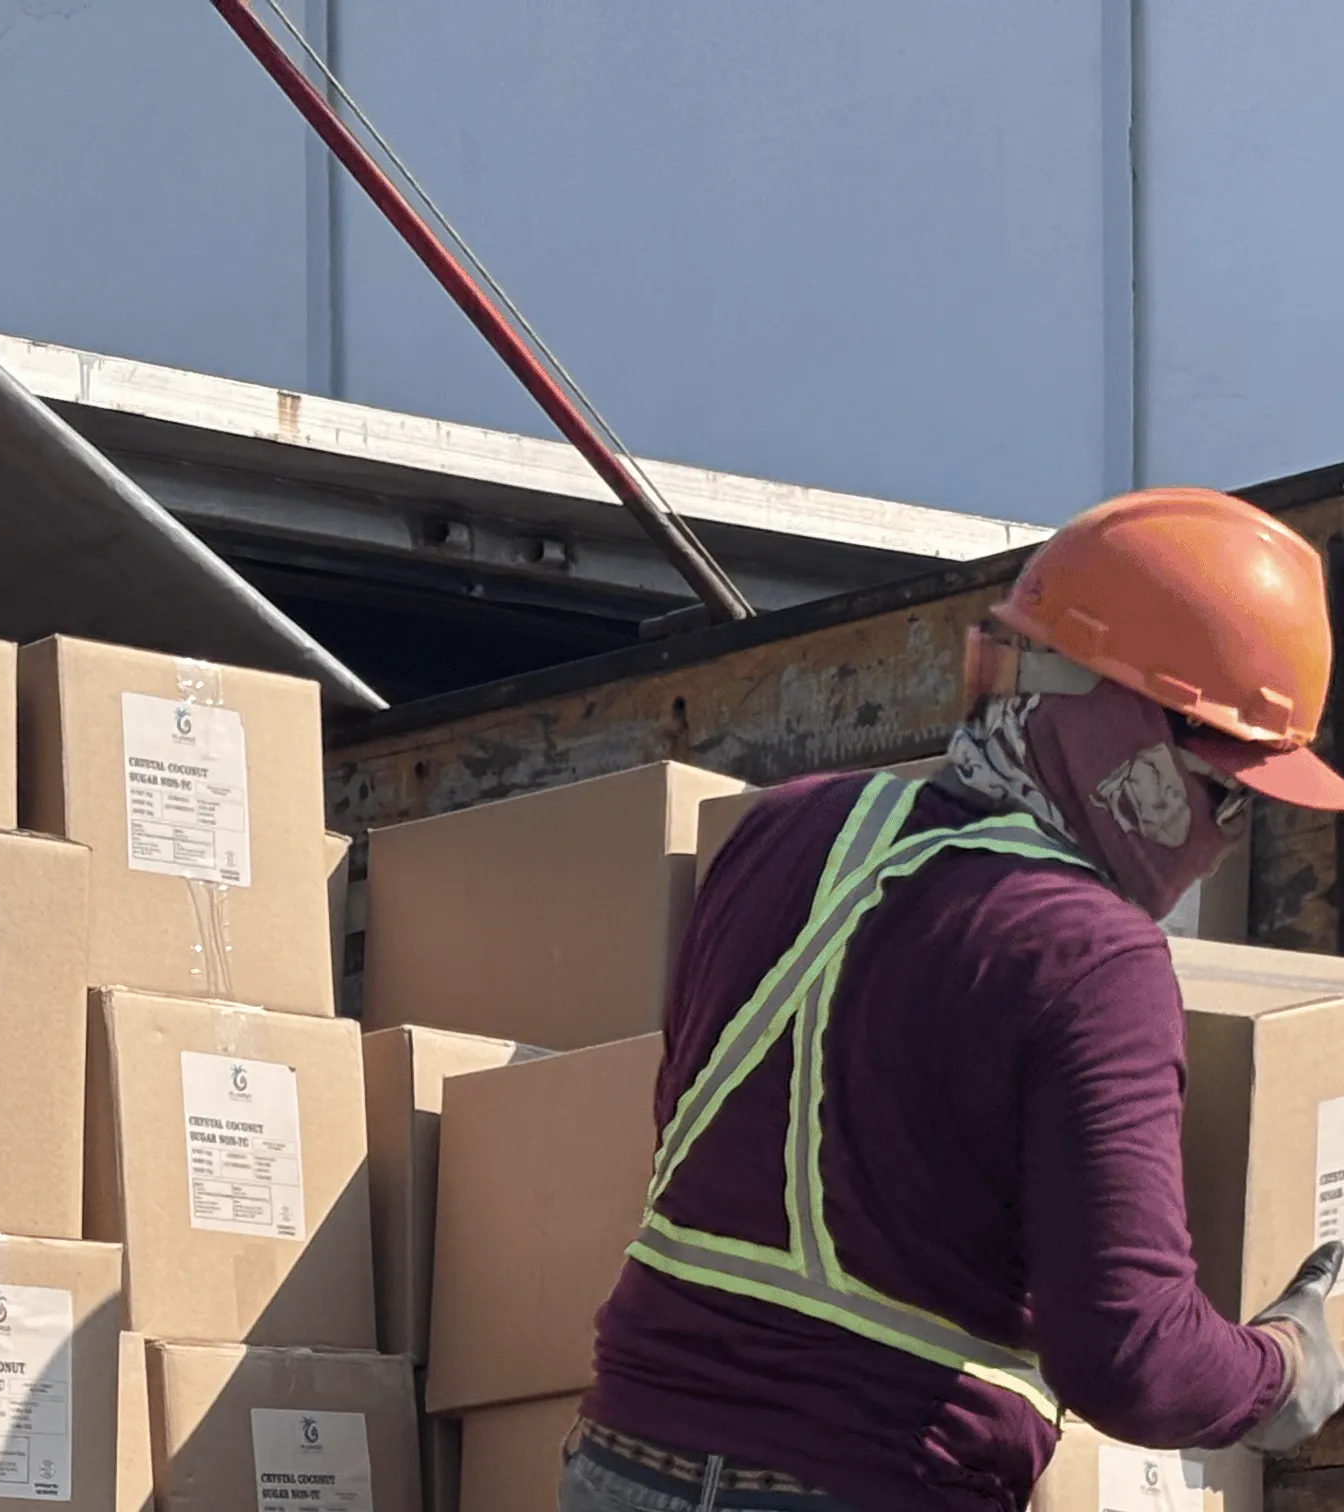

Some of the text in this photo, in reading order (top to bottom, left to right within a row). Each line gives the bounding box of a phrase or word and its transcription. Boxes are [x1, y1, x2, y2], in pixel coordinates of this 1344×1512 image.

[129, 757, 209, 778] CRYSTAL COCONUT
[129, 772, 158, 785] SUGAR
